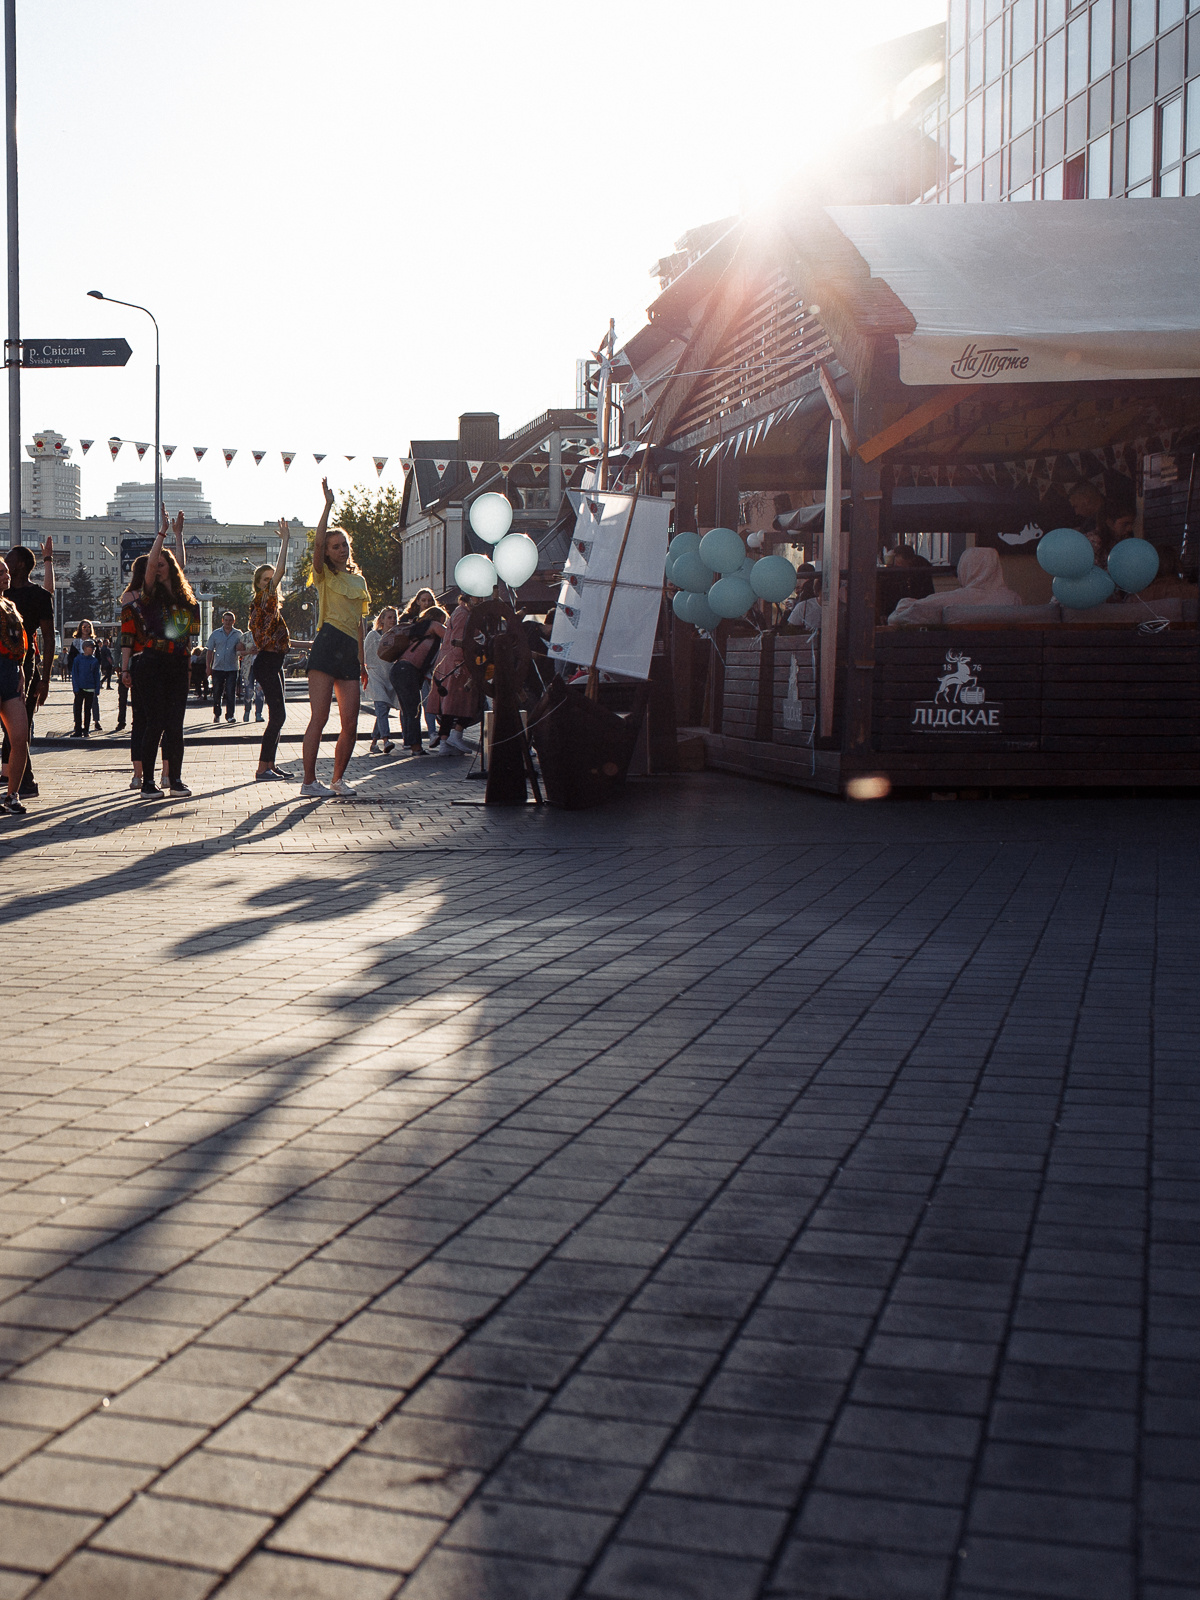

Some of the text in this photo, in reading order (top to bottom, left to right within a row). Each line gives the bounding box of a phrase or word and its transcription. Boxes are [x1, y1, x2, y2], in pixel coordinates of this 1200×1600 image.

[29, 345, 86, 359] р. Свіслач
[912, 708, 1000, 728] ЛІДСКАЕ
